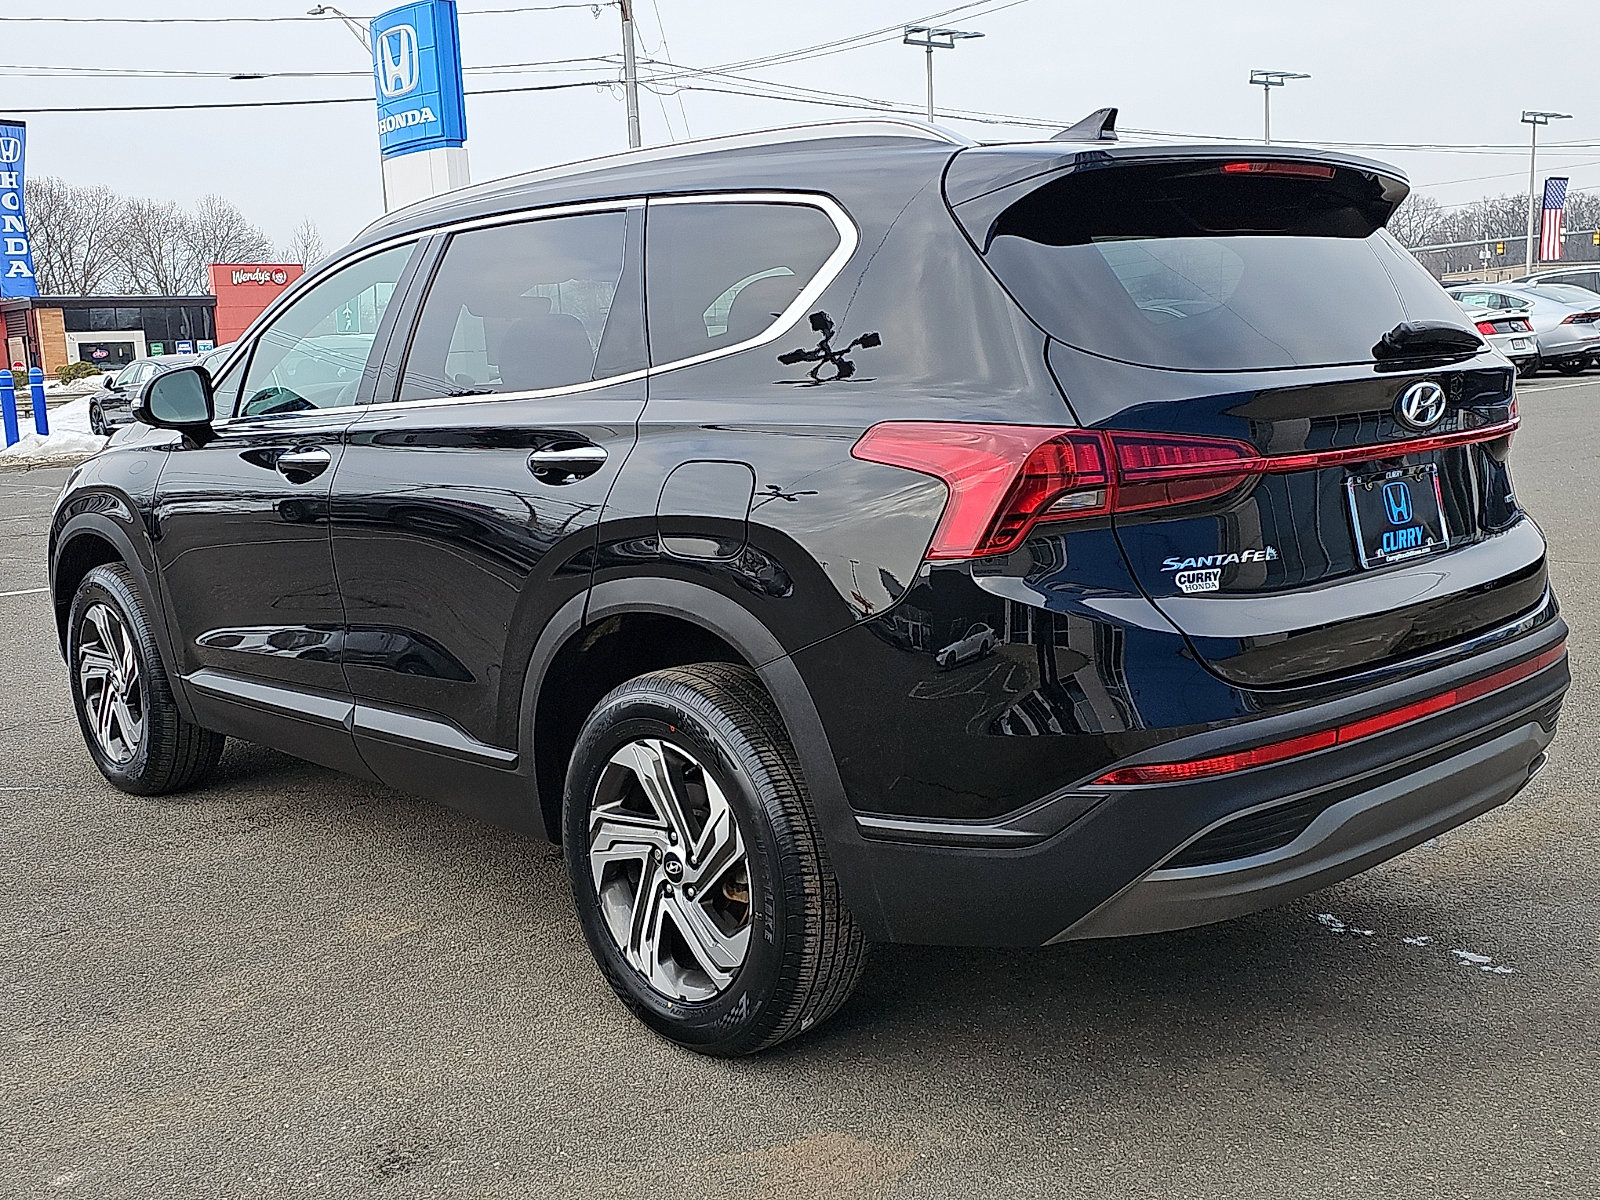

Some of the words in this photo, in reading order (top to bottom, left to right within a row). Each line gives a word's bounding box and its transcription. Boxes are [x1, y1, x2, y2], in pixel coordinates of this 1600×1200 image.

[378, 107, 437, 134] HONDA
[0, 171, 33, 278] HONDA
[232, 267, 270, 285] Wendy's
[1382, 526, 1423, 553] CURRY
[1160, 553, 1240, 572] SANTA
[1240, 549, 1266, 563] FE
[1178, 570, 1219, 585] CURRY
[1184, 581, 1218, 592] HONDA
